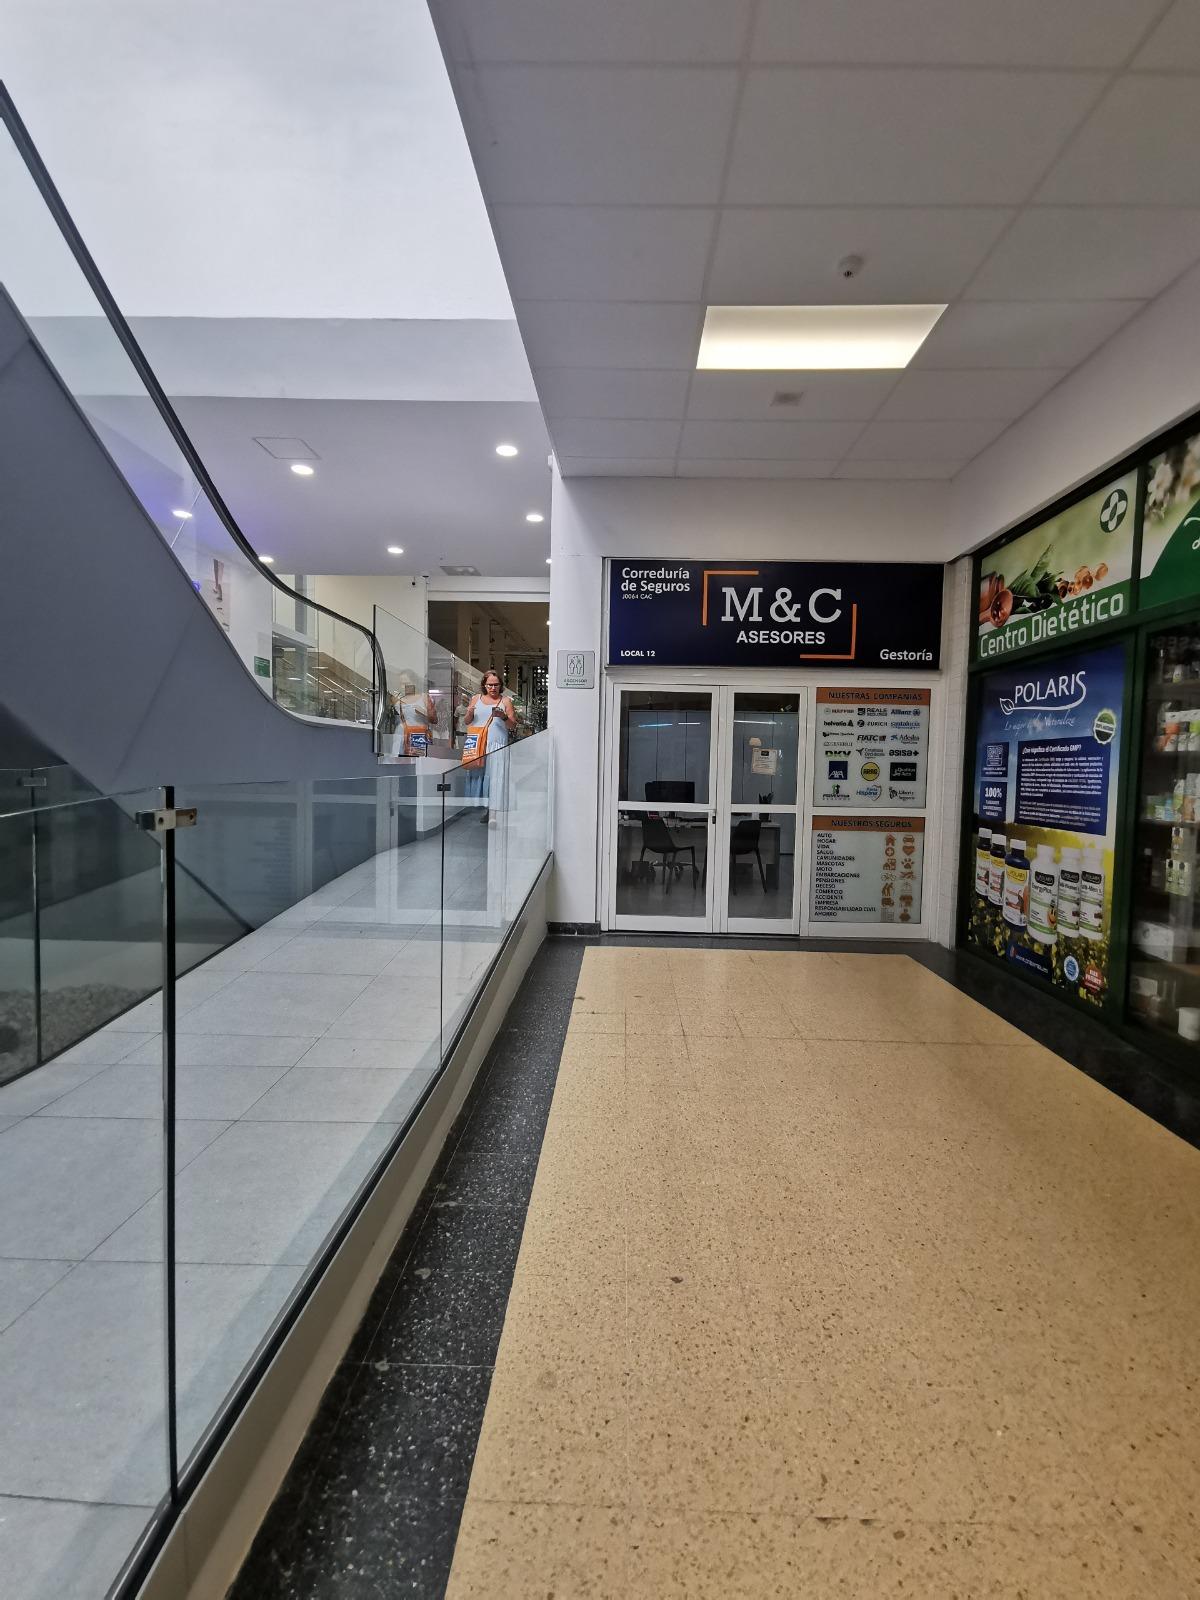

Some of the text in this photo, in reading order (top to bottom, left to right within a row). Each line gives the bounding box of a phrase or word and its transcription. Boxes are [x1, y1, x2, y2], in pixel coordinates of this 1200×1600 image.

[622, 567, 690, 579] Correduría
[621, 580, 690, 594] de Seguros
[980, 593, 1124, 658] Centro Dietético
[736, 630, 826, 645] ASESORES
[879, 648, 933, 661] Gestoría
[1014, 670, 1087, 704] POLARIS
[828, 692, 870, 700] NUESTRAS
[891, 708, 912, 716] Allianz
[829, 770, 845, 778] AXA
[984, 787, 1002, 798] 100%
[875, 820, 912, 828] SEGUROS
